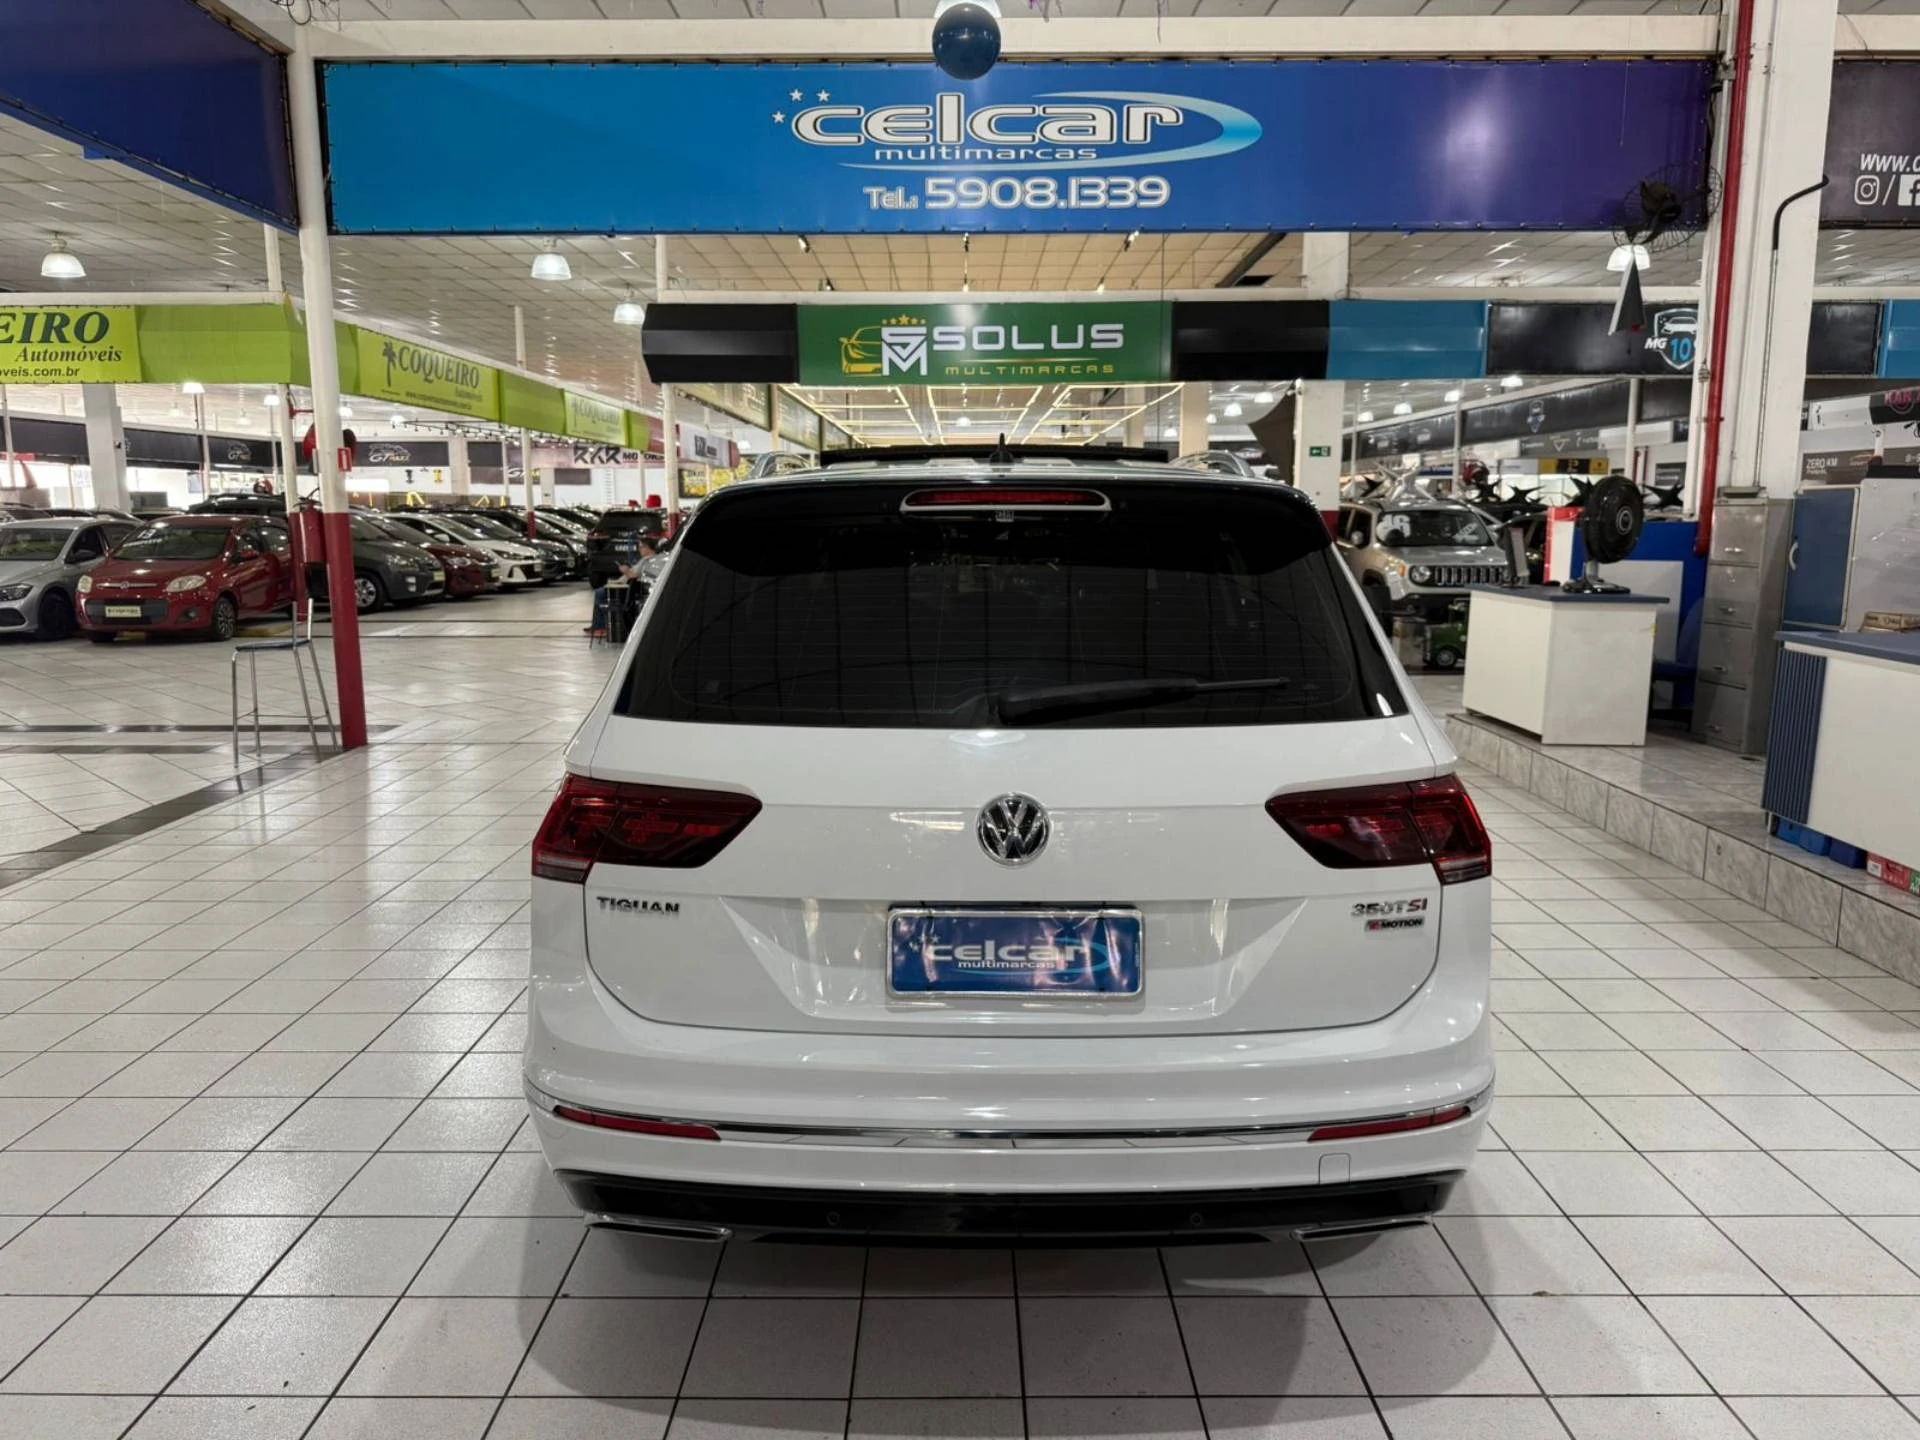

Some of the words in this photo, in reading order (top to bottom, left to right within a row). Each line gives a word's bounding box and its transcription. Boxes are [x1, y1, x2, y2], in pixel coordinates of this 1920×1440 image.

[791, 92, 1184, 147] celcar
[874, 145, 1098, 161] multimarcas
[924, 175, 1172, 211] 5908.1339
[932, 323, 1125, 351] SOLUS
[1644, 337, 1668, 350] MG
[14, 345, 123, 362] Automóveis
[0, 366, 80, 377] veis.com.br
[398, 345, 481, 389] COQUEIRO
[944, 364, 1115, 375] MULTIMARCAS
[596, 896, 681, 914] TIGUAN
[957, 959, 1057, 969] multimarcas
